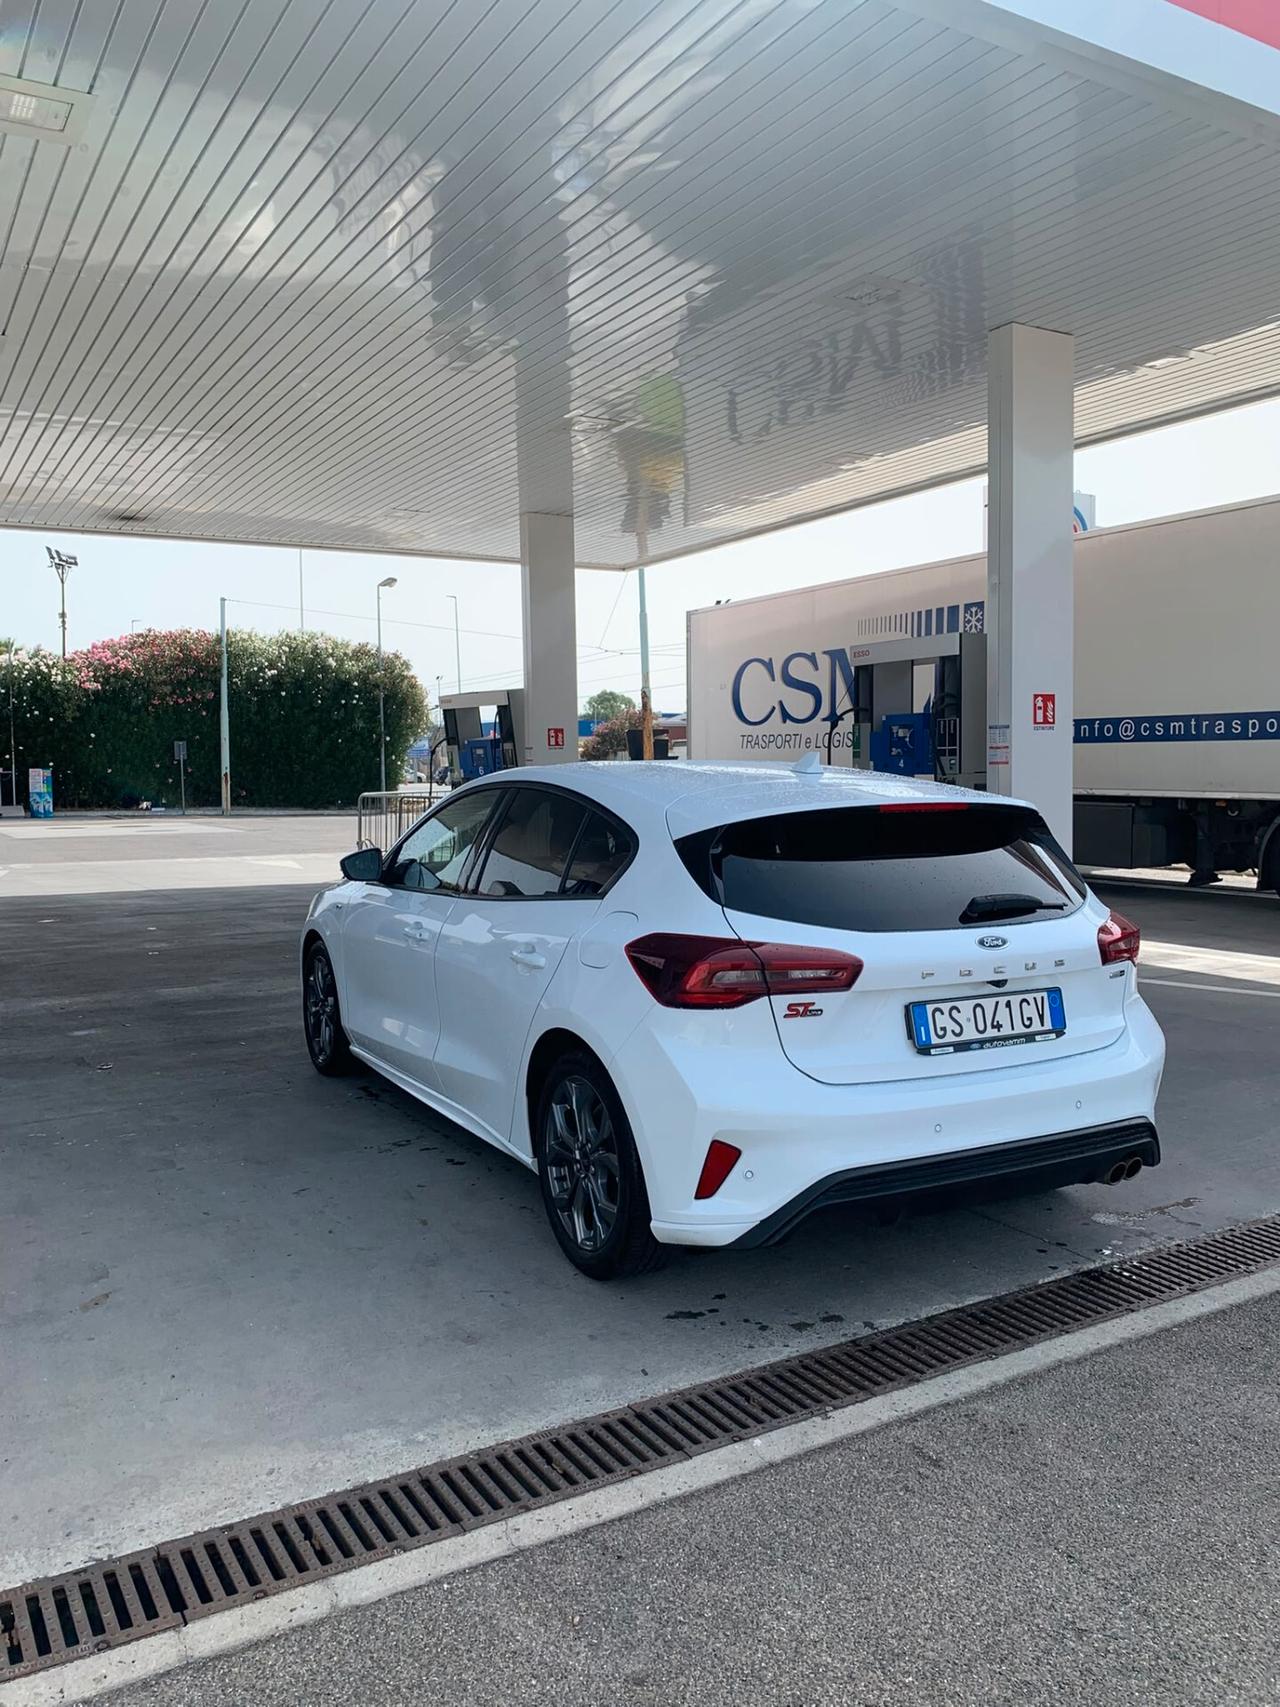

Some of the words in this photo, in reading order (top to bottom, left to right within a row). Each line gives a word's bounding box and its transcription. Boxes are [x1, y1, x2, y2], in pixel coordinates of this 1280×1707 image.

[853, 649, 871, 659] ESSO
[740, 733, 803, 750] TRASPORTI
[804, 737, 812, 749] e
[478, 766, 485, 776] 6
[898, 759, 905, 769] 4
[921, 959, 1065, 979] FOCUS
[783, 1002, 816, 1019] ST
[931, 1005, 964, 1039] GS
[972, 995, 1046, 1034] 041GV
